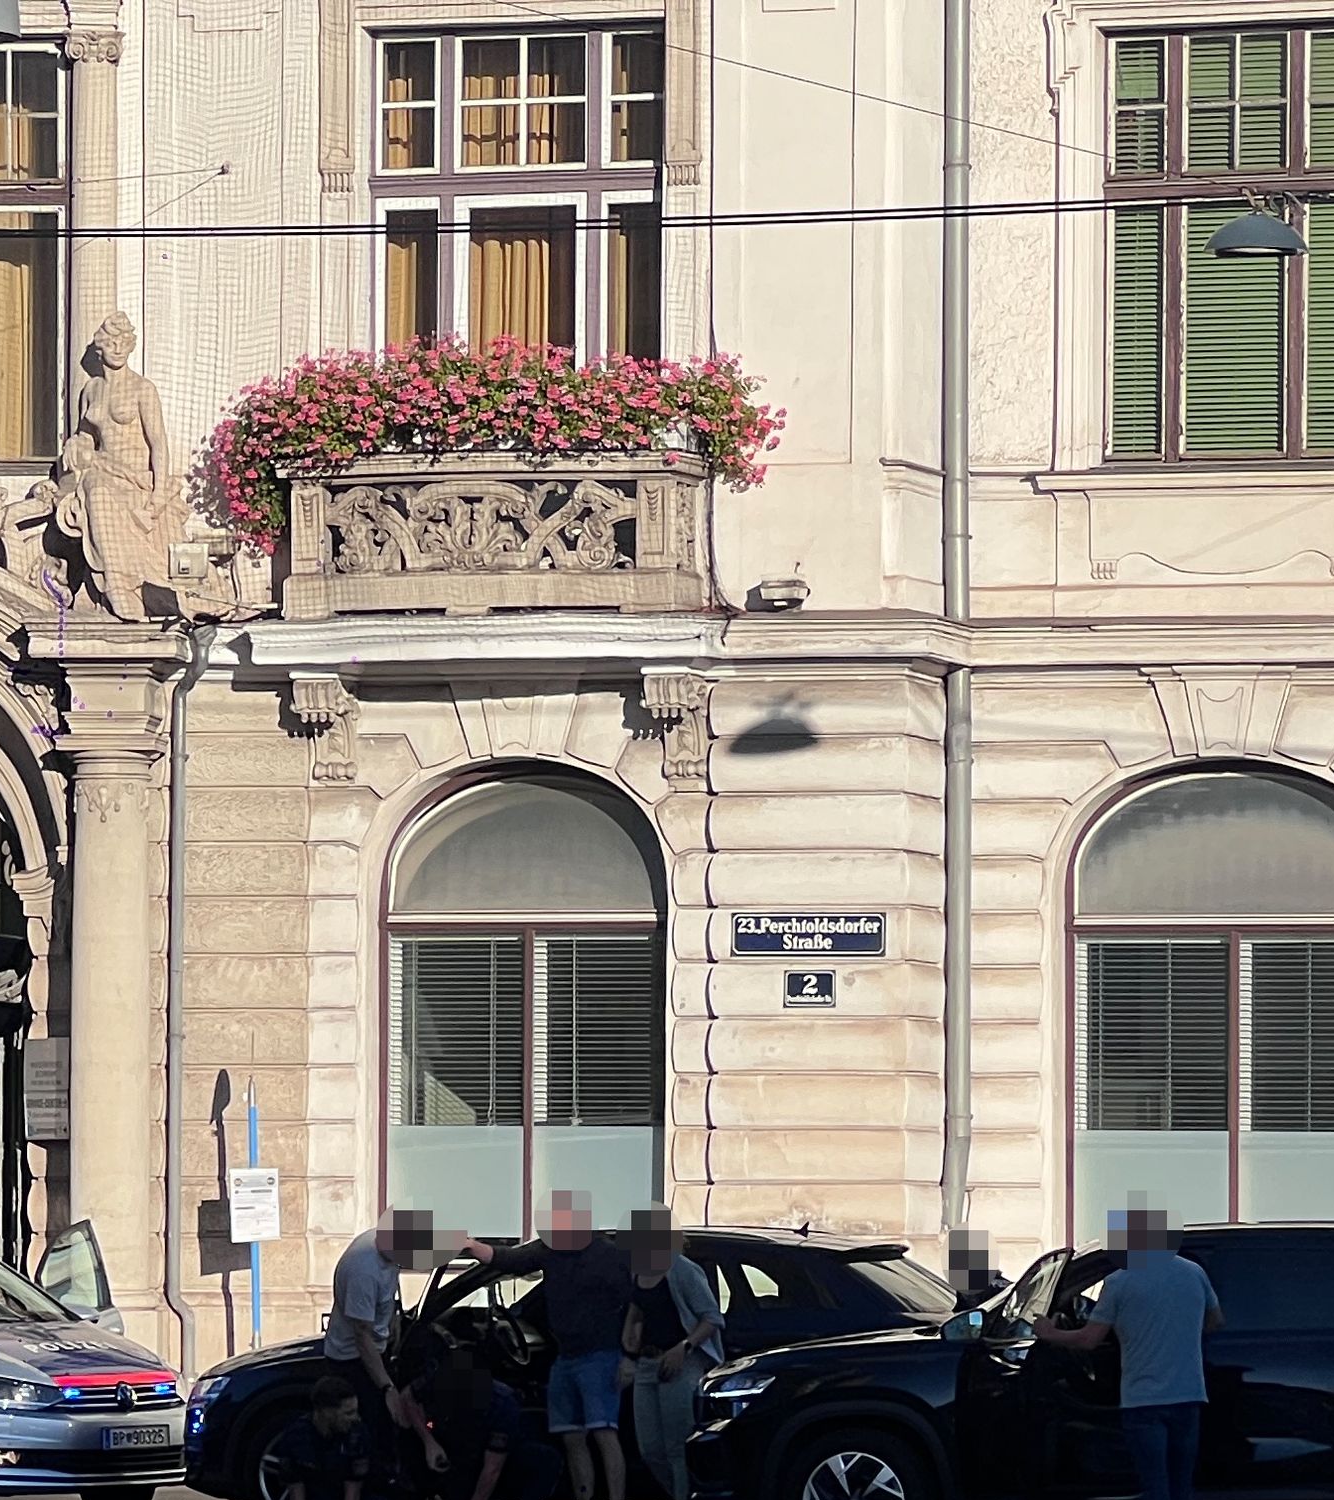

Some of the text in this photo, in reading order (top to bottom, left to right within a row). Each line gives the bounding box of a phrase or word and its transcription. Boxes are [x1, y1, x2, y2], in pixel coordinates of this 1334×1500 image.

[761, 917, 880, 934] Perchtoldsdorfer
[782, 934, 833, 950] Straße
[802, 974, 819, 995] 2
